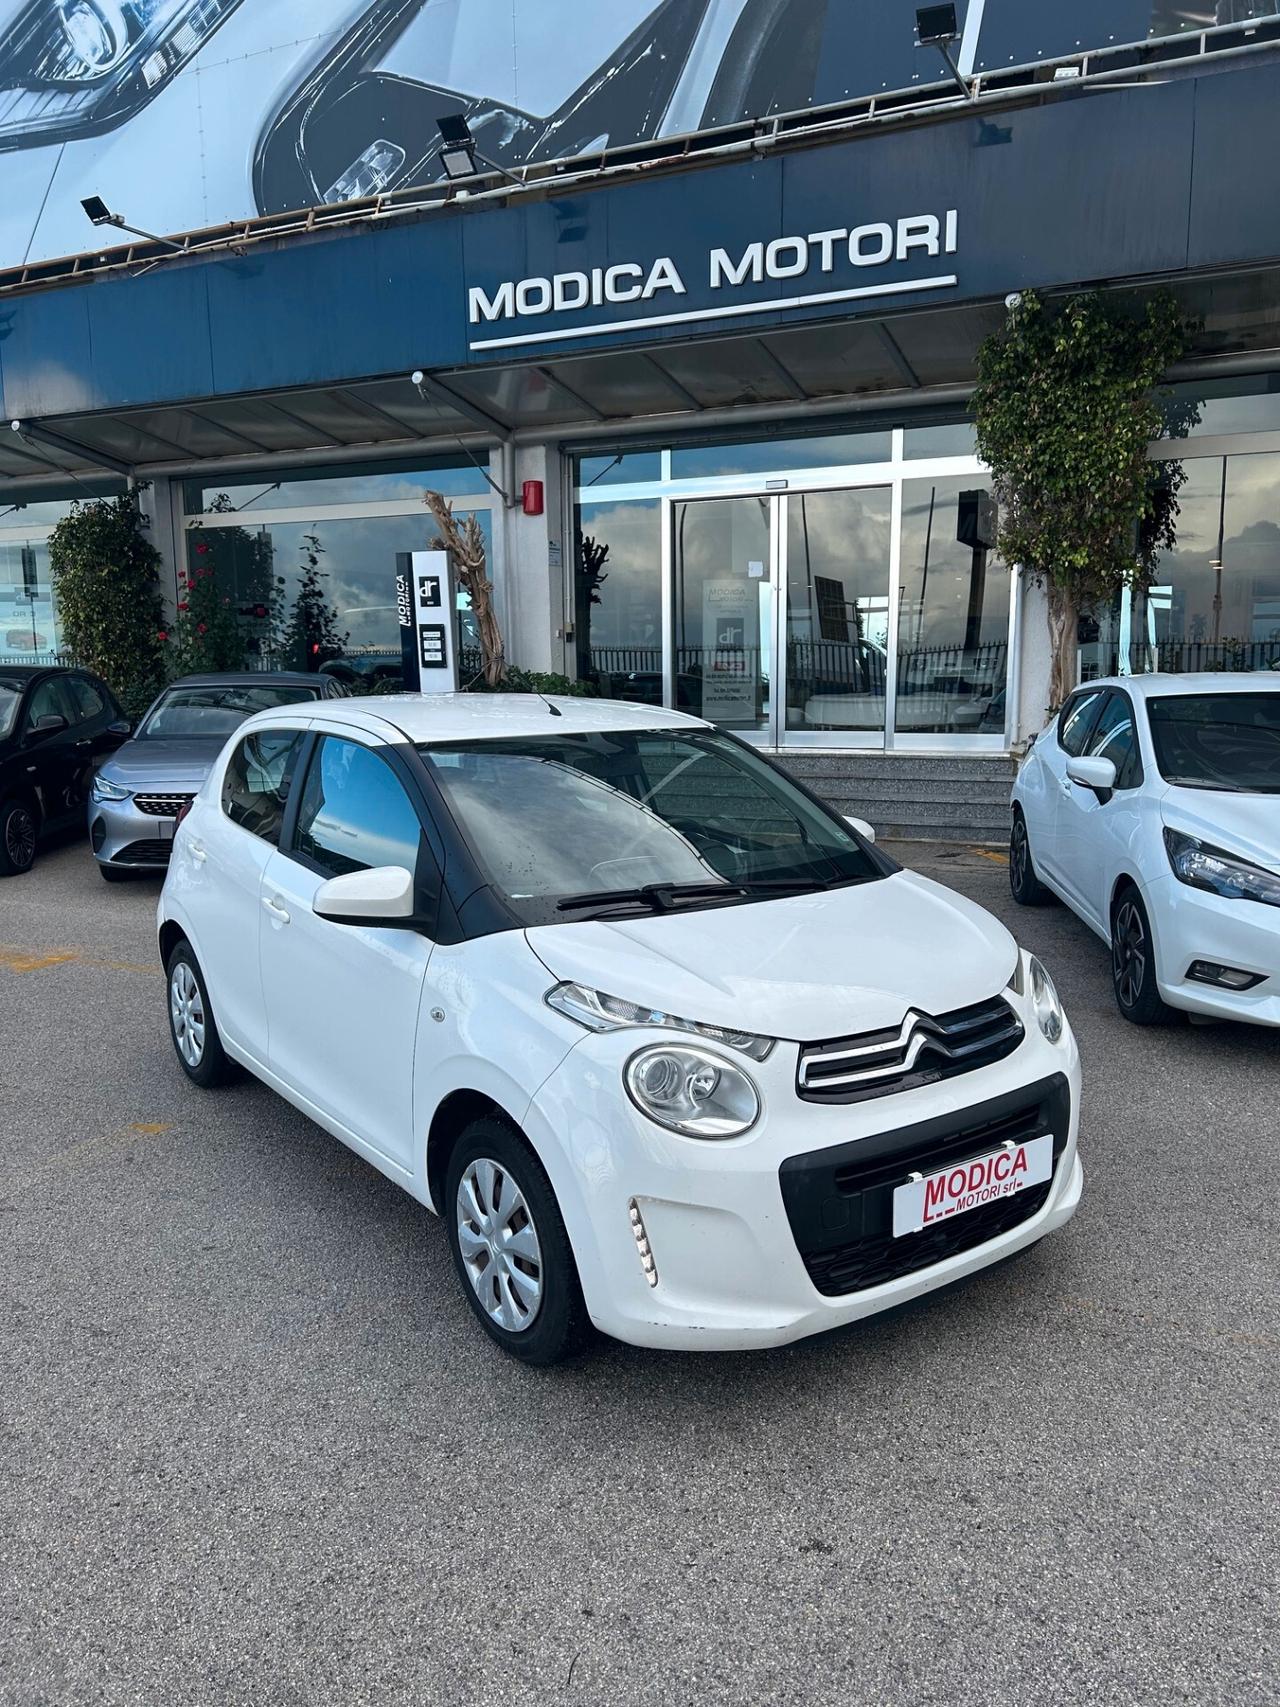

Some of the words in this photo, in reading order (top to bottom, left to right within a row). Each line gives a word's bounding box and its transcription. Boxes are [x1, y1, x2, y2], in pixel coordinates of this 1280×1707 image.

[468, 257, 686, 324] MODICA
[710, 209, 958, 289] MOTORI
[396, 574, 408, 626] MODICA
[419, 580, 438, 597] dr
[719, 627, 742, 644] dr
[924, 1147, 1028, 1206] MODICA
[956, 1188, 1001, 1211] MOTORI
[1003, 1178, 1017, 1195] srl
